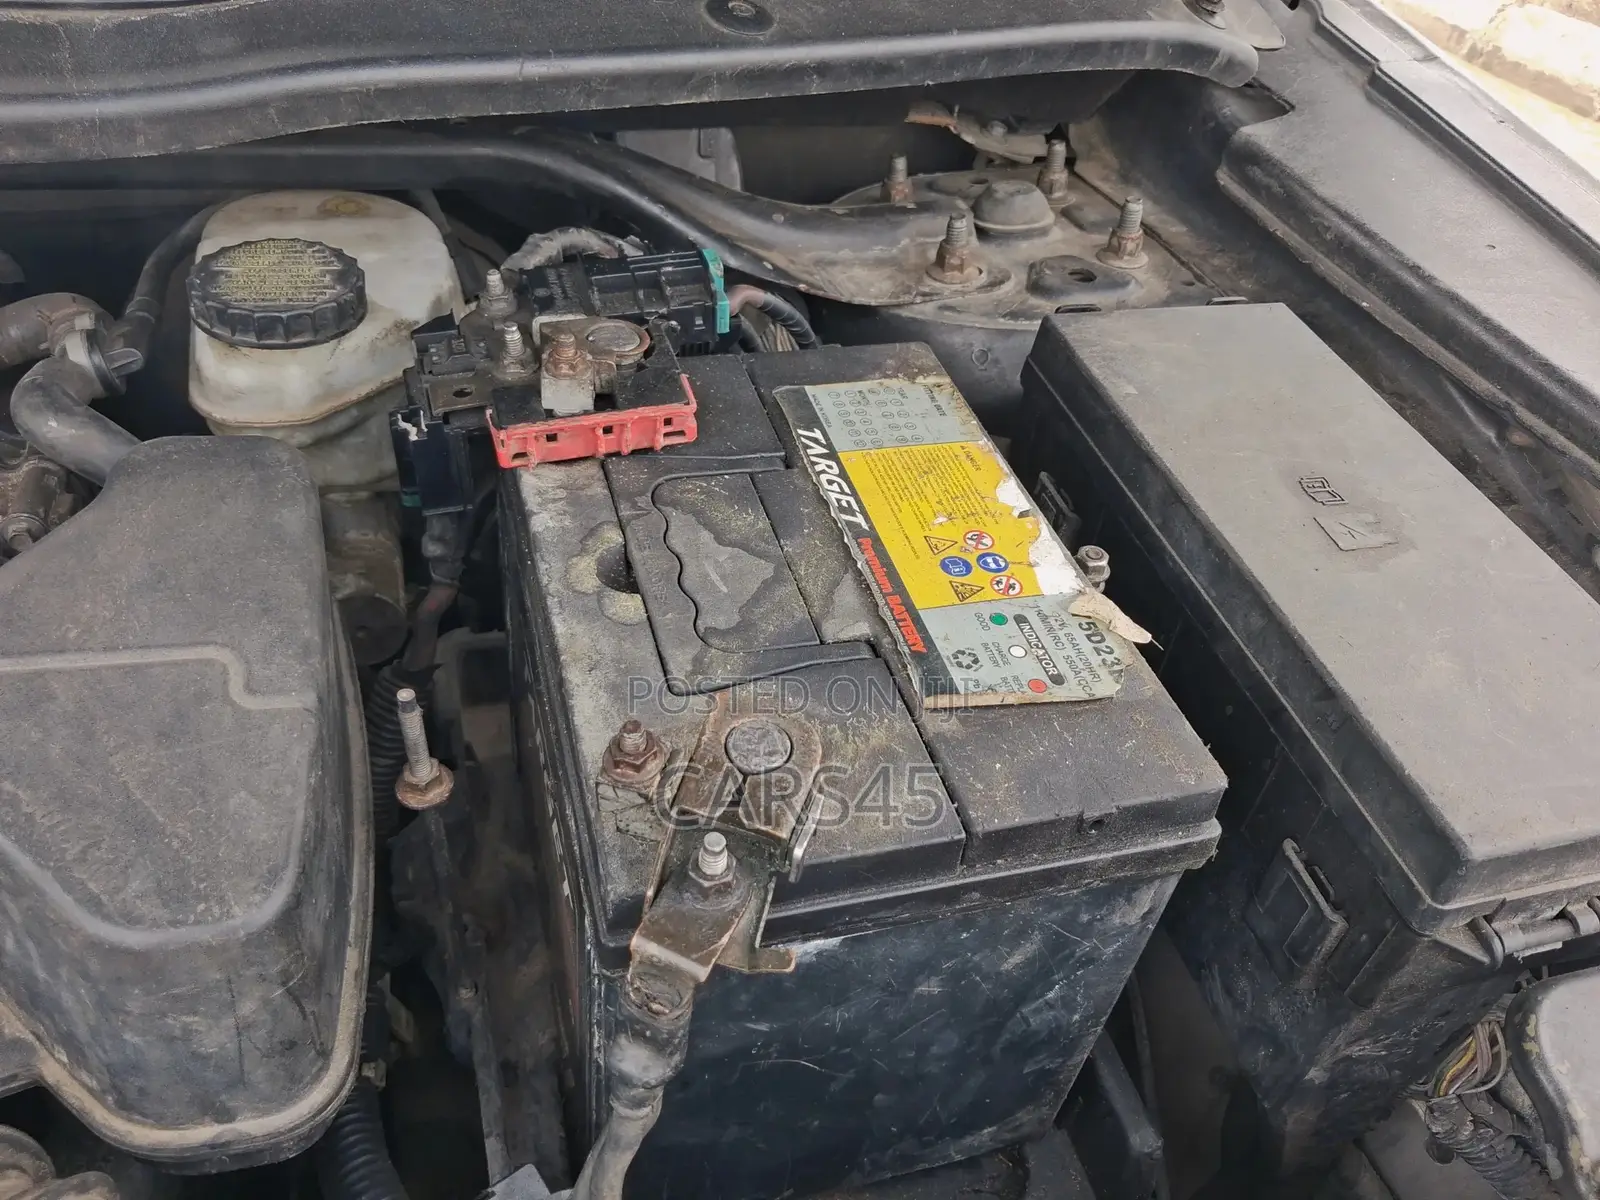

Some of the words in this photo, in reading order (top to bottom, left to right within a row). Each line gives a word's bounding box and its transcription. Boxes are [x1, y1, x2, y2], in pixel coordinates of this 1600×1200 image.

[796, 427, 870, 532] TARGET
[857, 537, 894, 593] Premium
[887, 595, 928, 653] BATTERY
[974, 612, 991, 632] GOOD
[981, 642, 1002, 668] BATTERY
[992, 641, 1011, 667] CHARGE
[1020, 622, 1058, 676] INDICATOR
[1064, 632, 1102, 683] 65AH(20HR)
